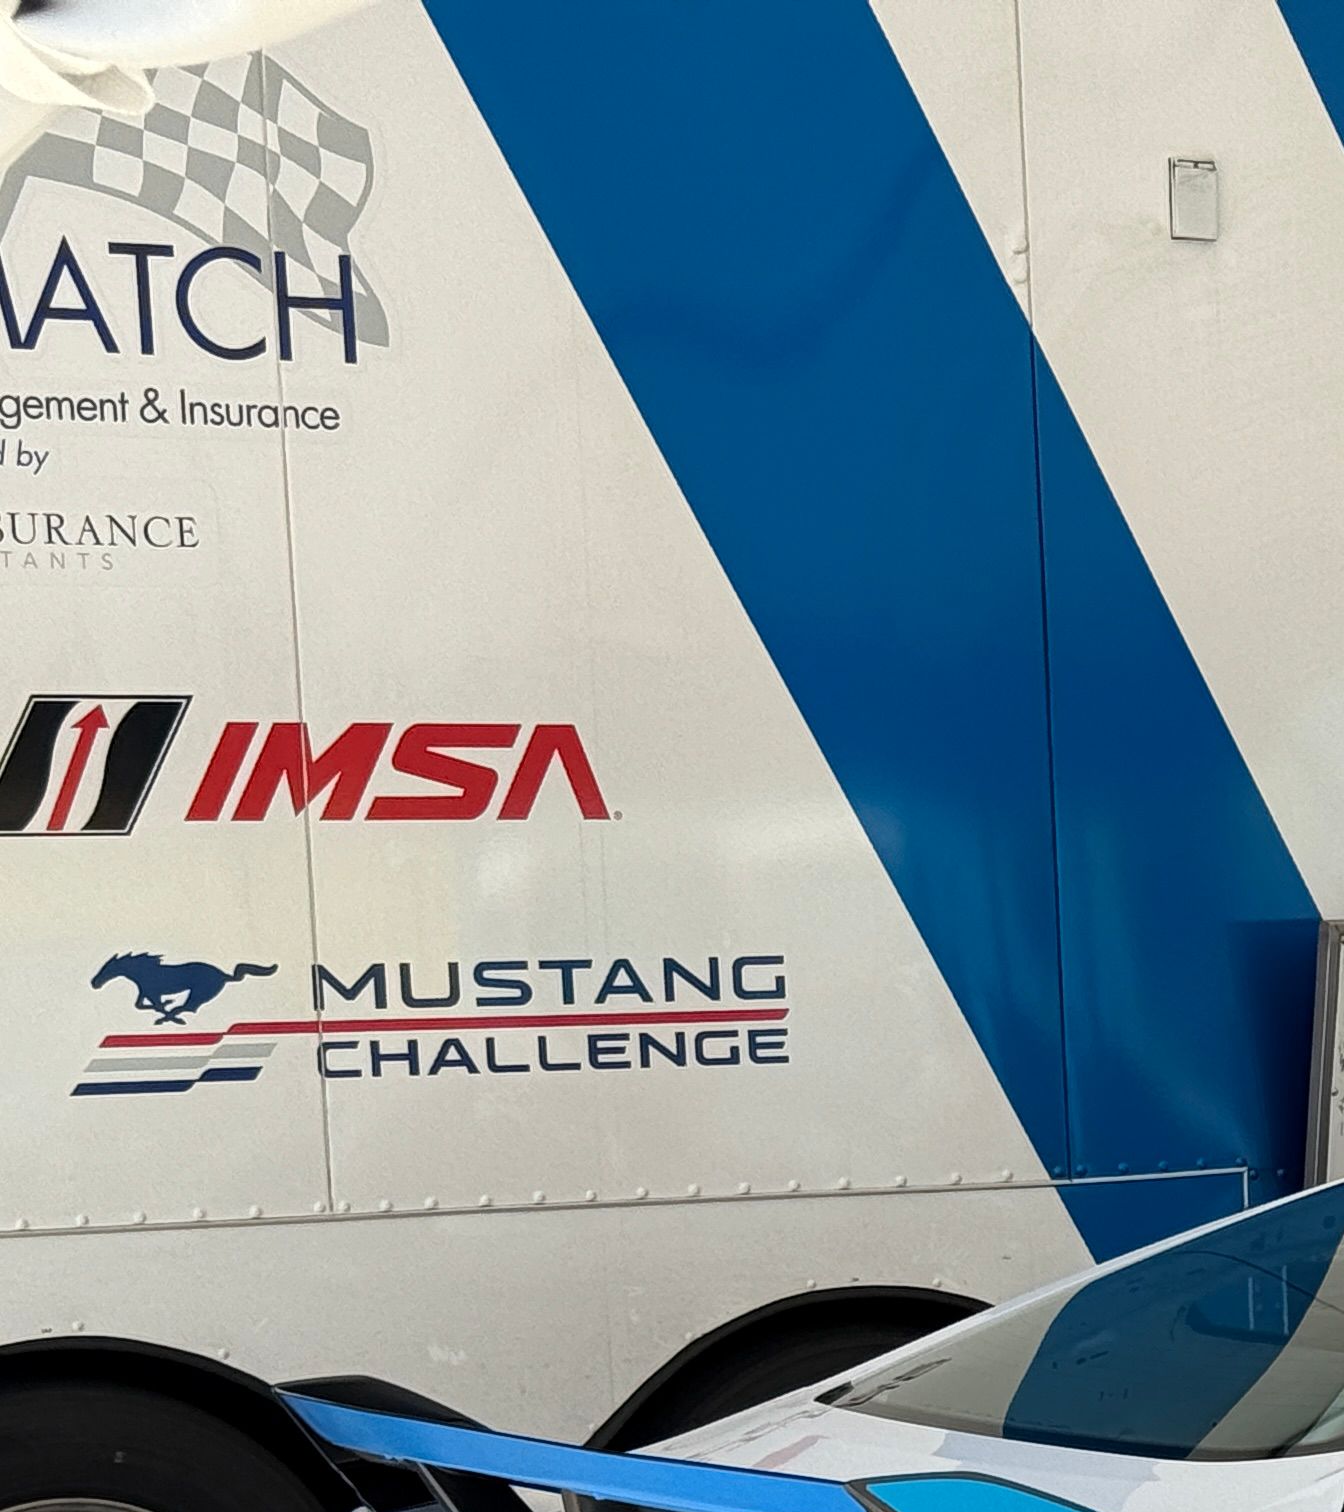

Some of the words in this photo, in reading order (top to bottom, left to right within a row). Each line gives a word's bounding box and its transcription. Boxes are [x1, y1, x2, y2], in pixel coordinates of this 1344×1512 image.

[139, 388, 170, 424] &
[180, 389, 341, 431] Insurance
[16, 439, 49, 475] by
[185, 721, 611, 822] IMSA
[312, 956, 786, 1012] MUSTANG
[317, 1028, 790, 1078] CHALLENGE
